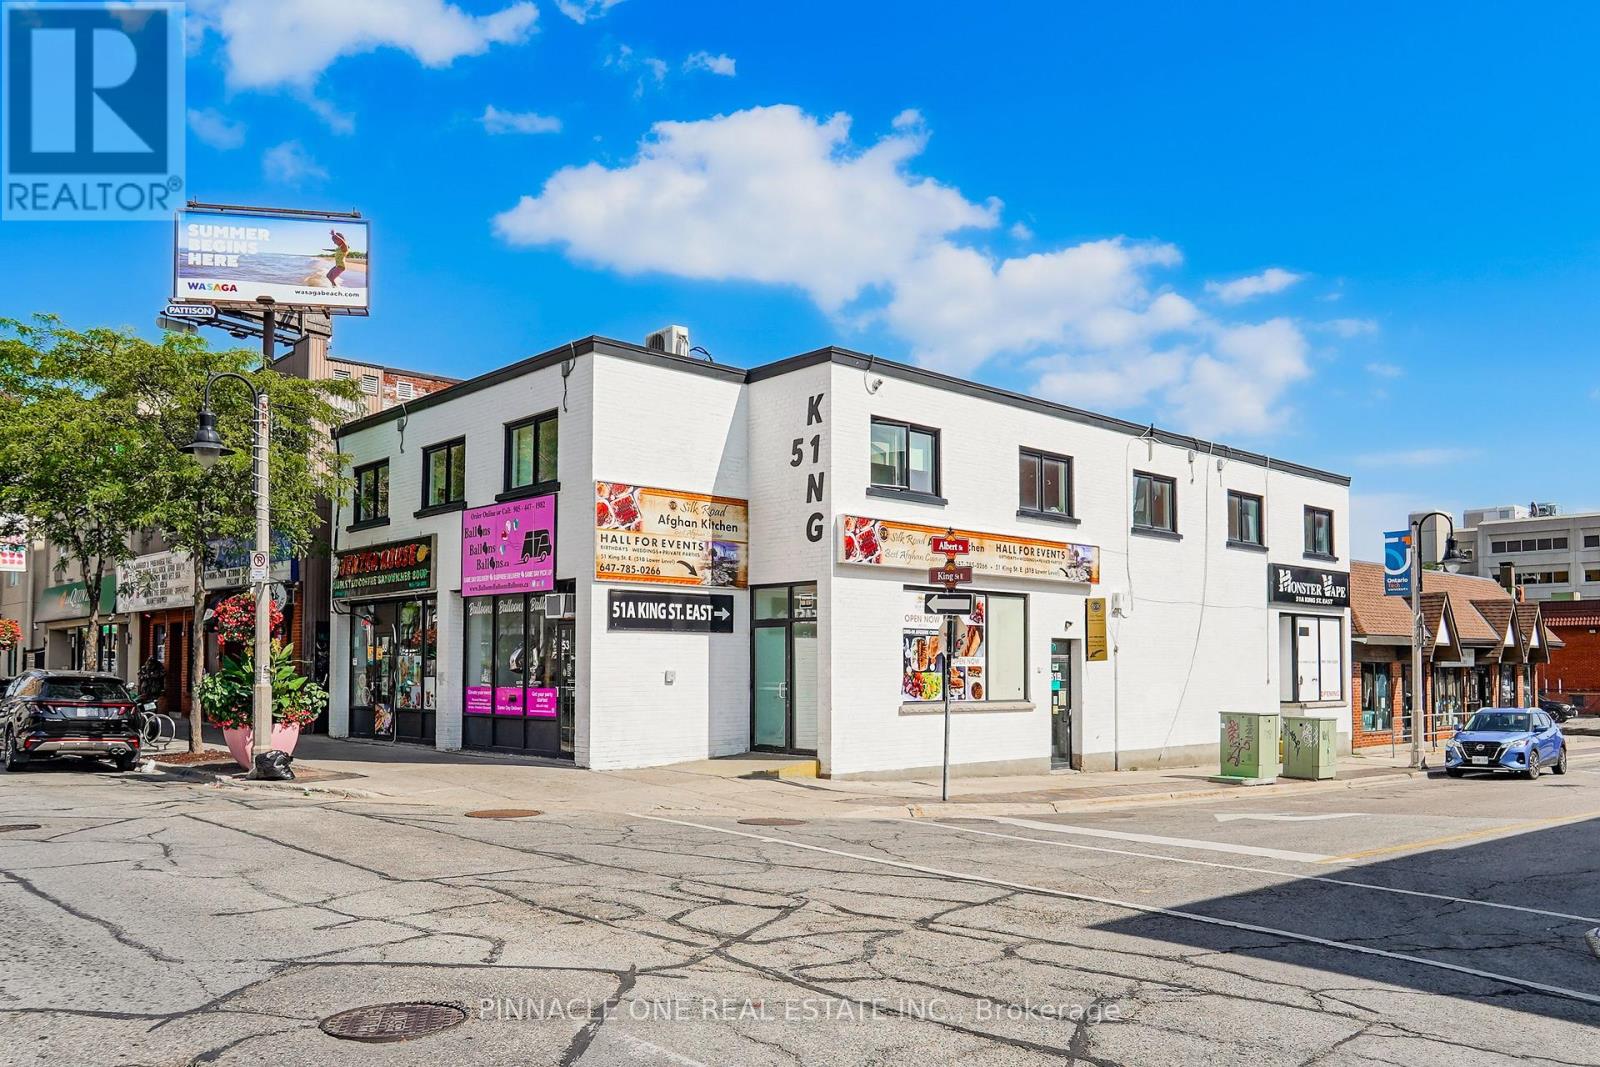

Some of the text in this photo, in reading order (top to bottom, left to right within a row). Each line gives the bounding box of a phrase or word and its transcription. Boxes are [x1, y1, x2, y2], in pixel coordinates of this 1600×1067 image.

[187, 223, 270, 241] SUMMER
[188, 238, 259, 254] BEGINS
[187, 252, 240, 267] HERE
[187, 282, 238, 292] WASAGA
[294, 288, 360, 298] wasagabeach.com
[168, 306, 213, 316] PATTISON
[680, 501, 727, 518] Silk Road
[657, 514, 738, 533] Afghan Kitchen
[600, 533, 704, 551] HALL FOR EVENTS
[938, 542, 958, 551] Albert
[996, 543, 1017, 555] HALL
[1019, 546, 1035, 556] FOR
[1036, 547, 1066, 559] EVENTS
[608, 554, 620, 562] King
[646, 556, 660, 564] Lower
[599, 563, 661, 575] 647-785-0266
[1002, 564, 1013, 573] King
[1035, 567, 1048, 575] Lower
[937, 571, 954, 582] King
[1278, 569, 1346, 598] MONSTER VAPE
[612, 601, 714, 621] 51A KING ST. EAST
[904, 614, 941, 624] OPEN NOW
